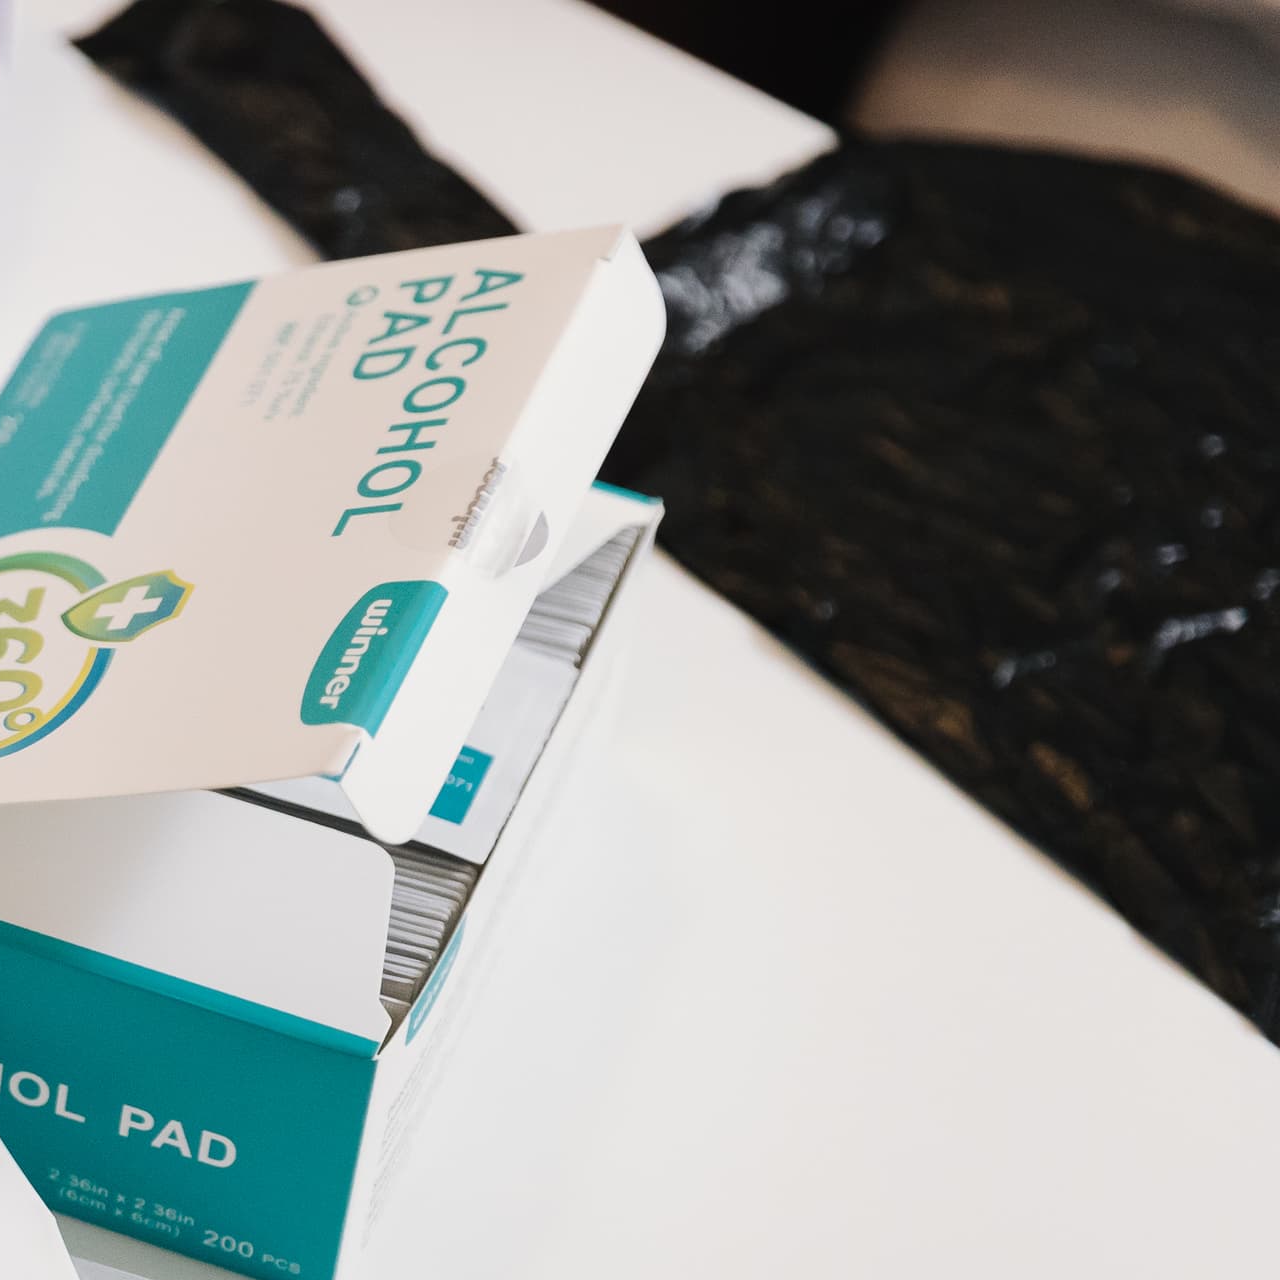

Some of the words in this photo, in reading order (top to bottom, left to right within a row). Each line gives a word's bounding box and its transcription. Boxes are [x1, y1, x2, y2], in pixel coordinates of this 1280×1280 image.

[352, 273, 458, 381] PAD
[331, 267, 526, 537] ALCOHOL
[318, 598, 393, 709] winner
[117, 1103, 238, 1169] PAD
[202, 1229, 255, 1259] 200
